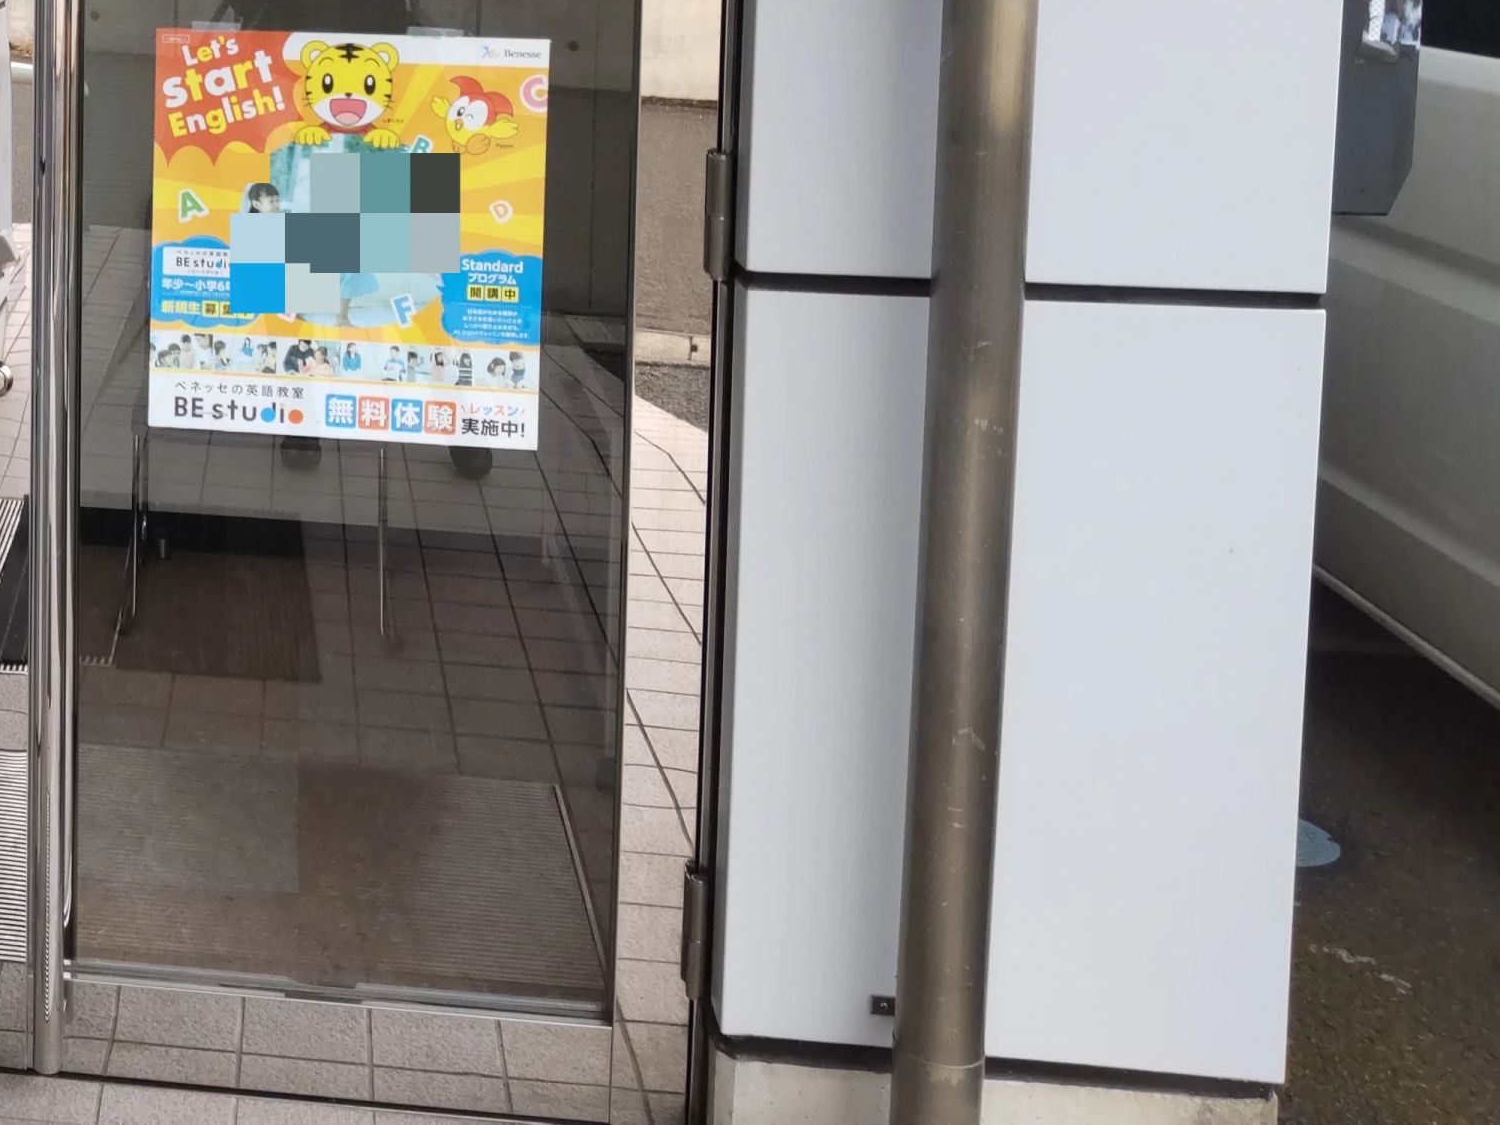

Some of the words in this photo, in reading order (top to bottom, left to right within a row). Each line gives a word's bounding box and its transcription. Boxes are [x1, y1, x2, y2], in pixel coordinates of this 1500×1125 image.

[182, 35, 239, 66] Let's
[503, 48, 542, 59] Benesse
[168, 86, 286, 137] English!
[176, 256, 190, 267] BE
[193, 258, 230, 269] studi
[462, 258, 524, 274] Standard
[467, 272, 517, 286] プログラム
[175, 381, 305, 400] ベネッセの英語教室
[174, 396, 204, 418] BE
[211, 396, 305, 425] studio
[327, 395, 456, 433] 無料体験
[469, 403, 519, 418] レッスン
[461, 417, 526, 439] 実施中!
